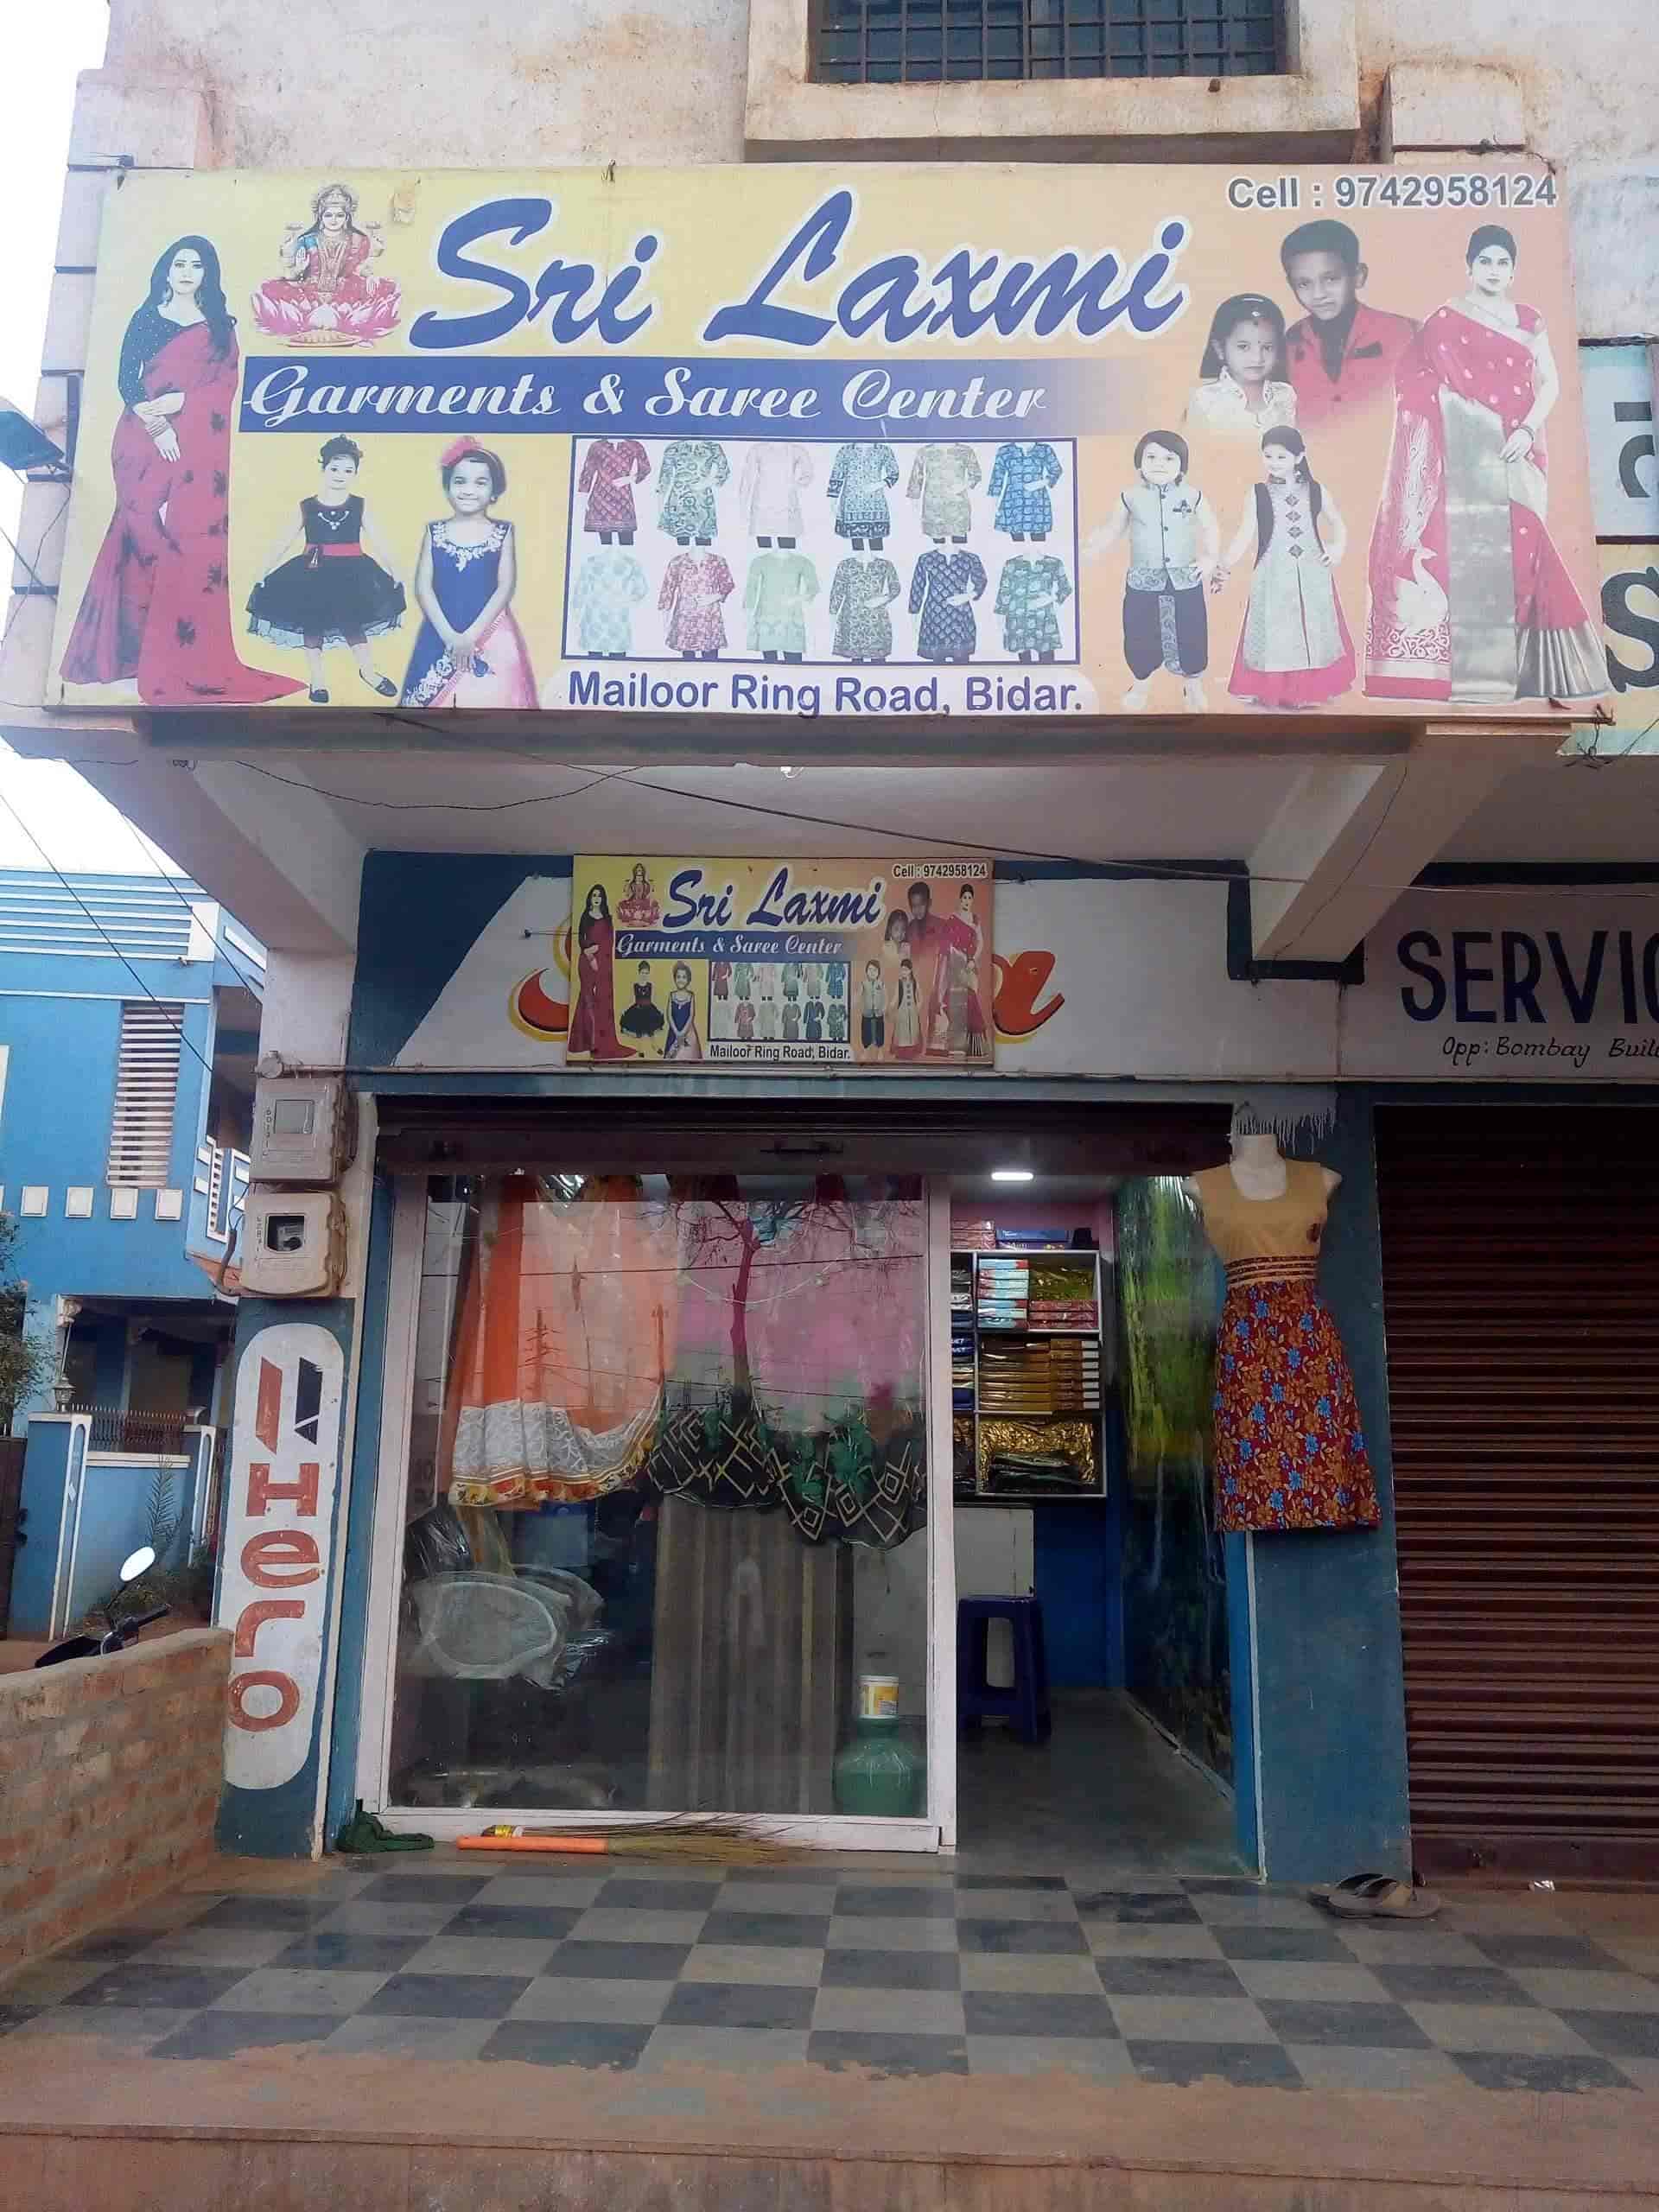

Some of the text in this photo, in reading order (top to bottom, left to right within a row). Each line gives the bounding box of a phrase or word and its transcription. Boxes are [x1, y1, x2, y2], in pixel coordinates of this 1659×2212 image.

[1228, 177, 1298, 208] Cell
[1335, 176, 1556, 207] 9742958124
[409, 189, 1185, 350] Sri Laxmi
[243, 365, 1047, 427] Garments & Saree Center
[569, 671, 1083, 719] Mailoor Ring Road, Bidar.
[893, 866, 913, 877] Cell
[924, 864, 985, 877] 9742958124
[663, 868, 881, 928] Sri Laxmi
[616, 933, 843, 957] Garments & Saree Center
[710, 1045, 851, 1061] Mailoor Ring Road, Bidar.
[1497, 1037, 1591, 1068] Bombay
